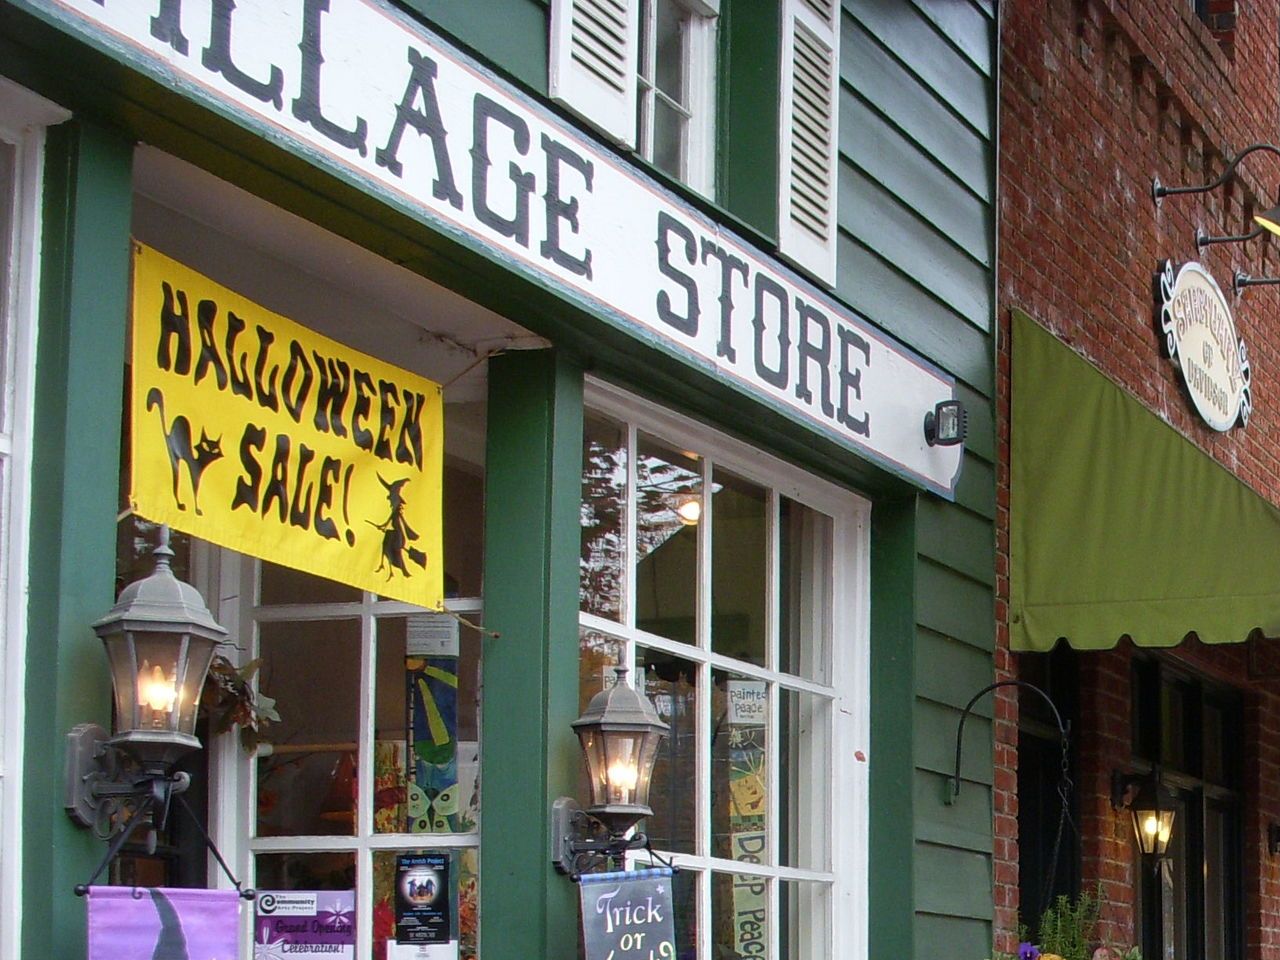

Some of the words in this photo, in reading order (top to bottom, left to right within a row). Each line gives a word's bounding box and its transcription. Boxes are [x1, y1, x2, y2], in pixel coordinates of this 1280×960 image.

[150, 0, 594, 281] LLAGE
[655, 210, 871, 439] STORE
[156, 280, 427, 468] HALLOWEEN
[1187, 357, 1229, 416] DAVIDSON
[231, 424, 356, 547] SALE!
[275, 920, 307, 934] Grand
[596, 885, 664, 933] Trick
[281, 940, 345, 954] Celebration!
[620, 933, 646, 951] or
